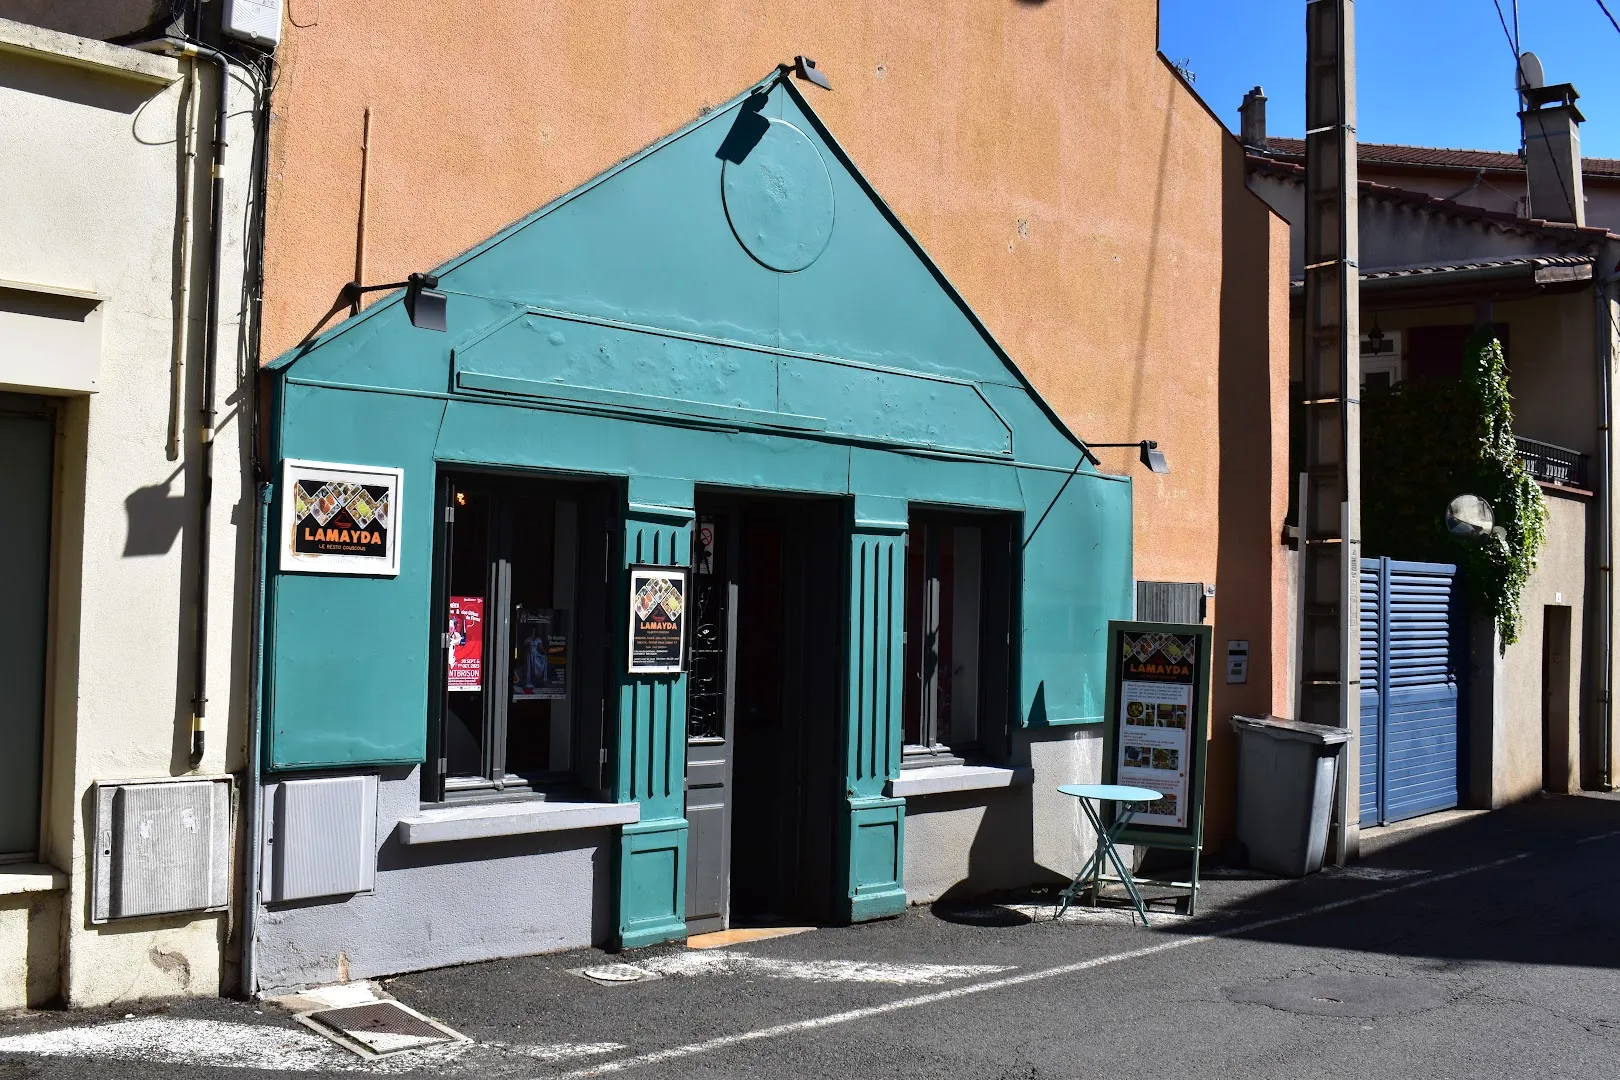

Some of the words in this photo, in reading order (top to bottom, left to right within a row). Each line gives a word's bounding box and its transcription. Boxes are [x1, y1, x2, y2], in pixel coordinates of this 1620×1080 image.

[304, 528, 382, 544] LAMAYDA
[640, 622, 677, 630] LAMAYDA
[1130, 663, 1189, 675] LAMAYDA
